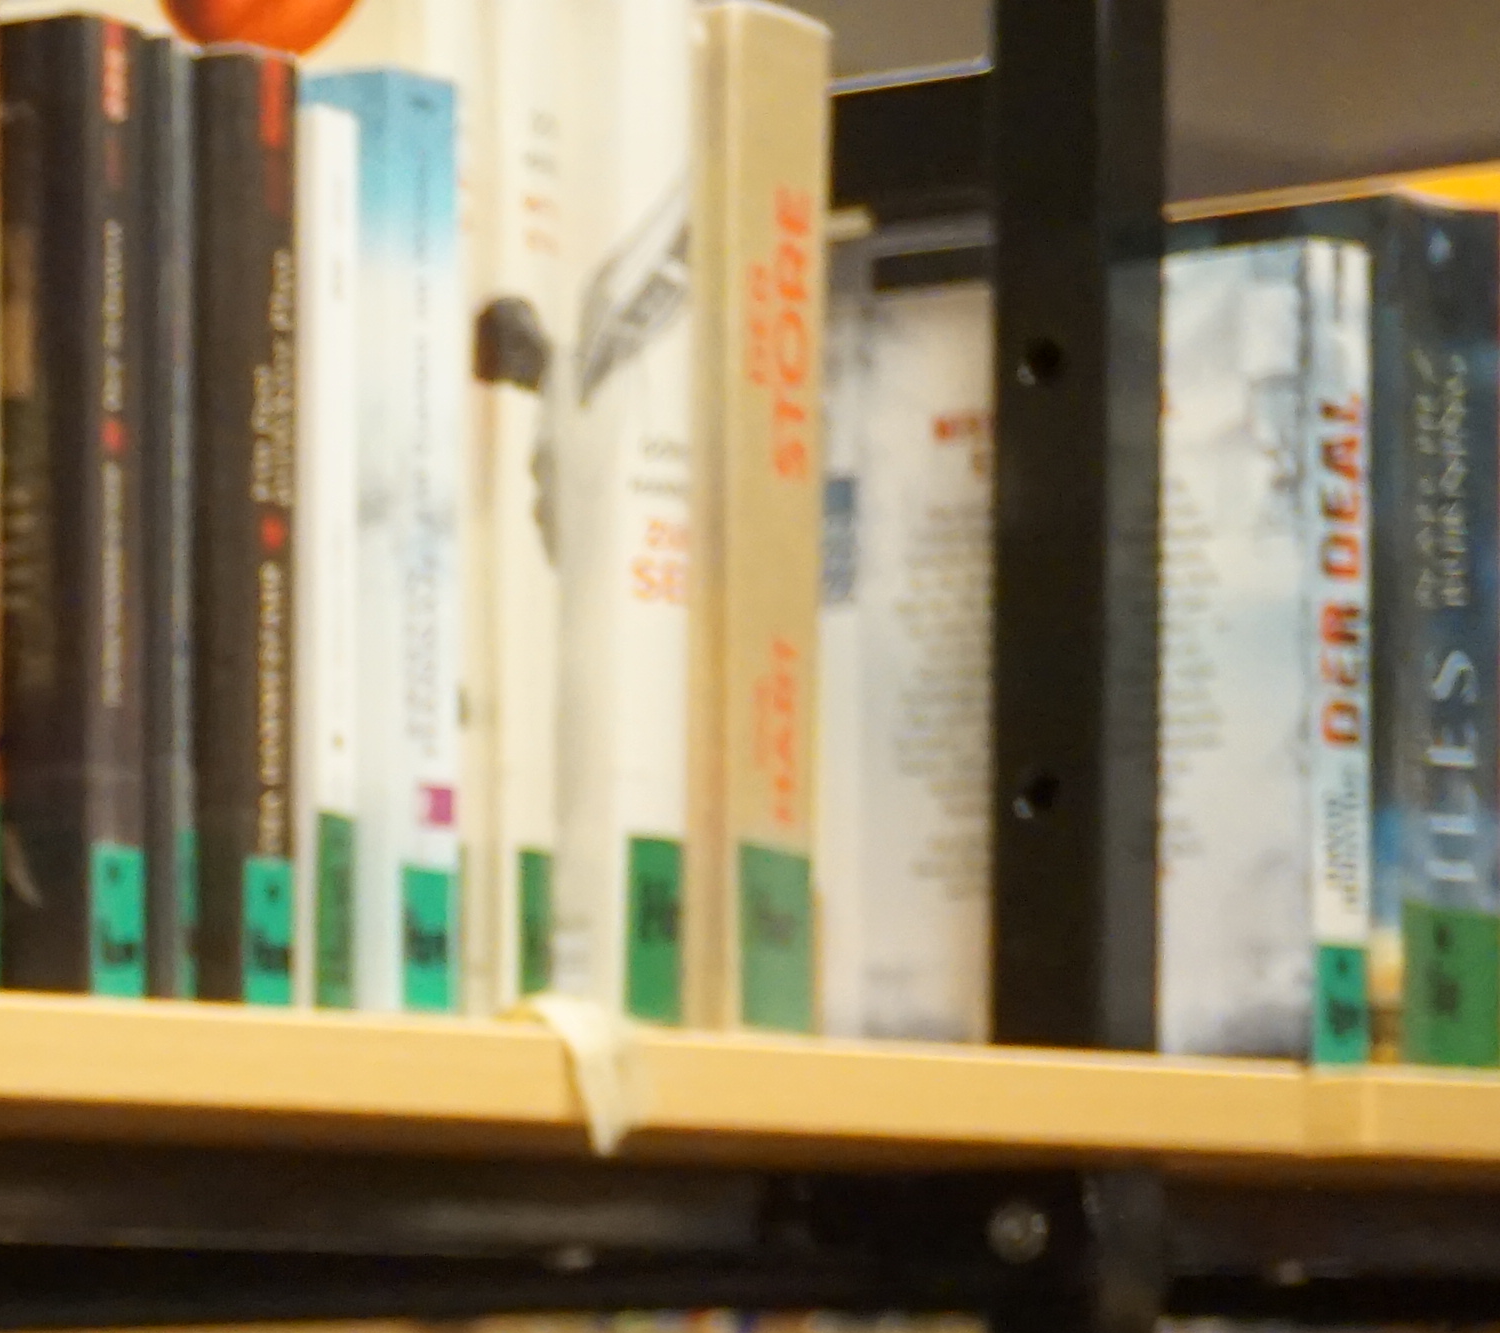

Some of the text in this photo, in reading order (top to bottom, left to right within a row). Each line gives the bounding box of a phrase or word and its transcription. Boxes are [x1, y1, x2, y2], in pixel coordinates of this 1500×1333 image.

[1316, 393, 1365, 584] DEAL
[1318, 602, 1365, 750] DER
[1422, 648, 1482, 884] ILES
